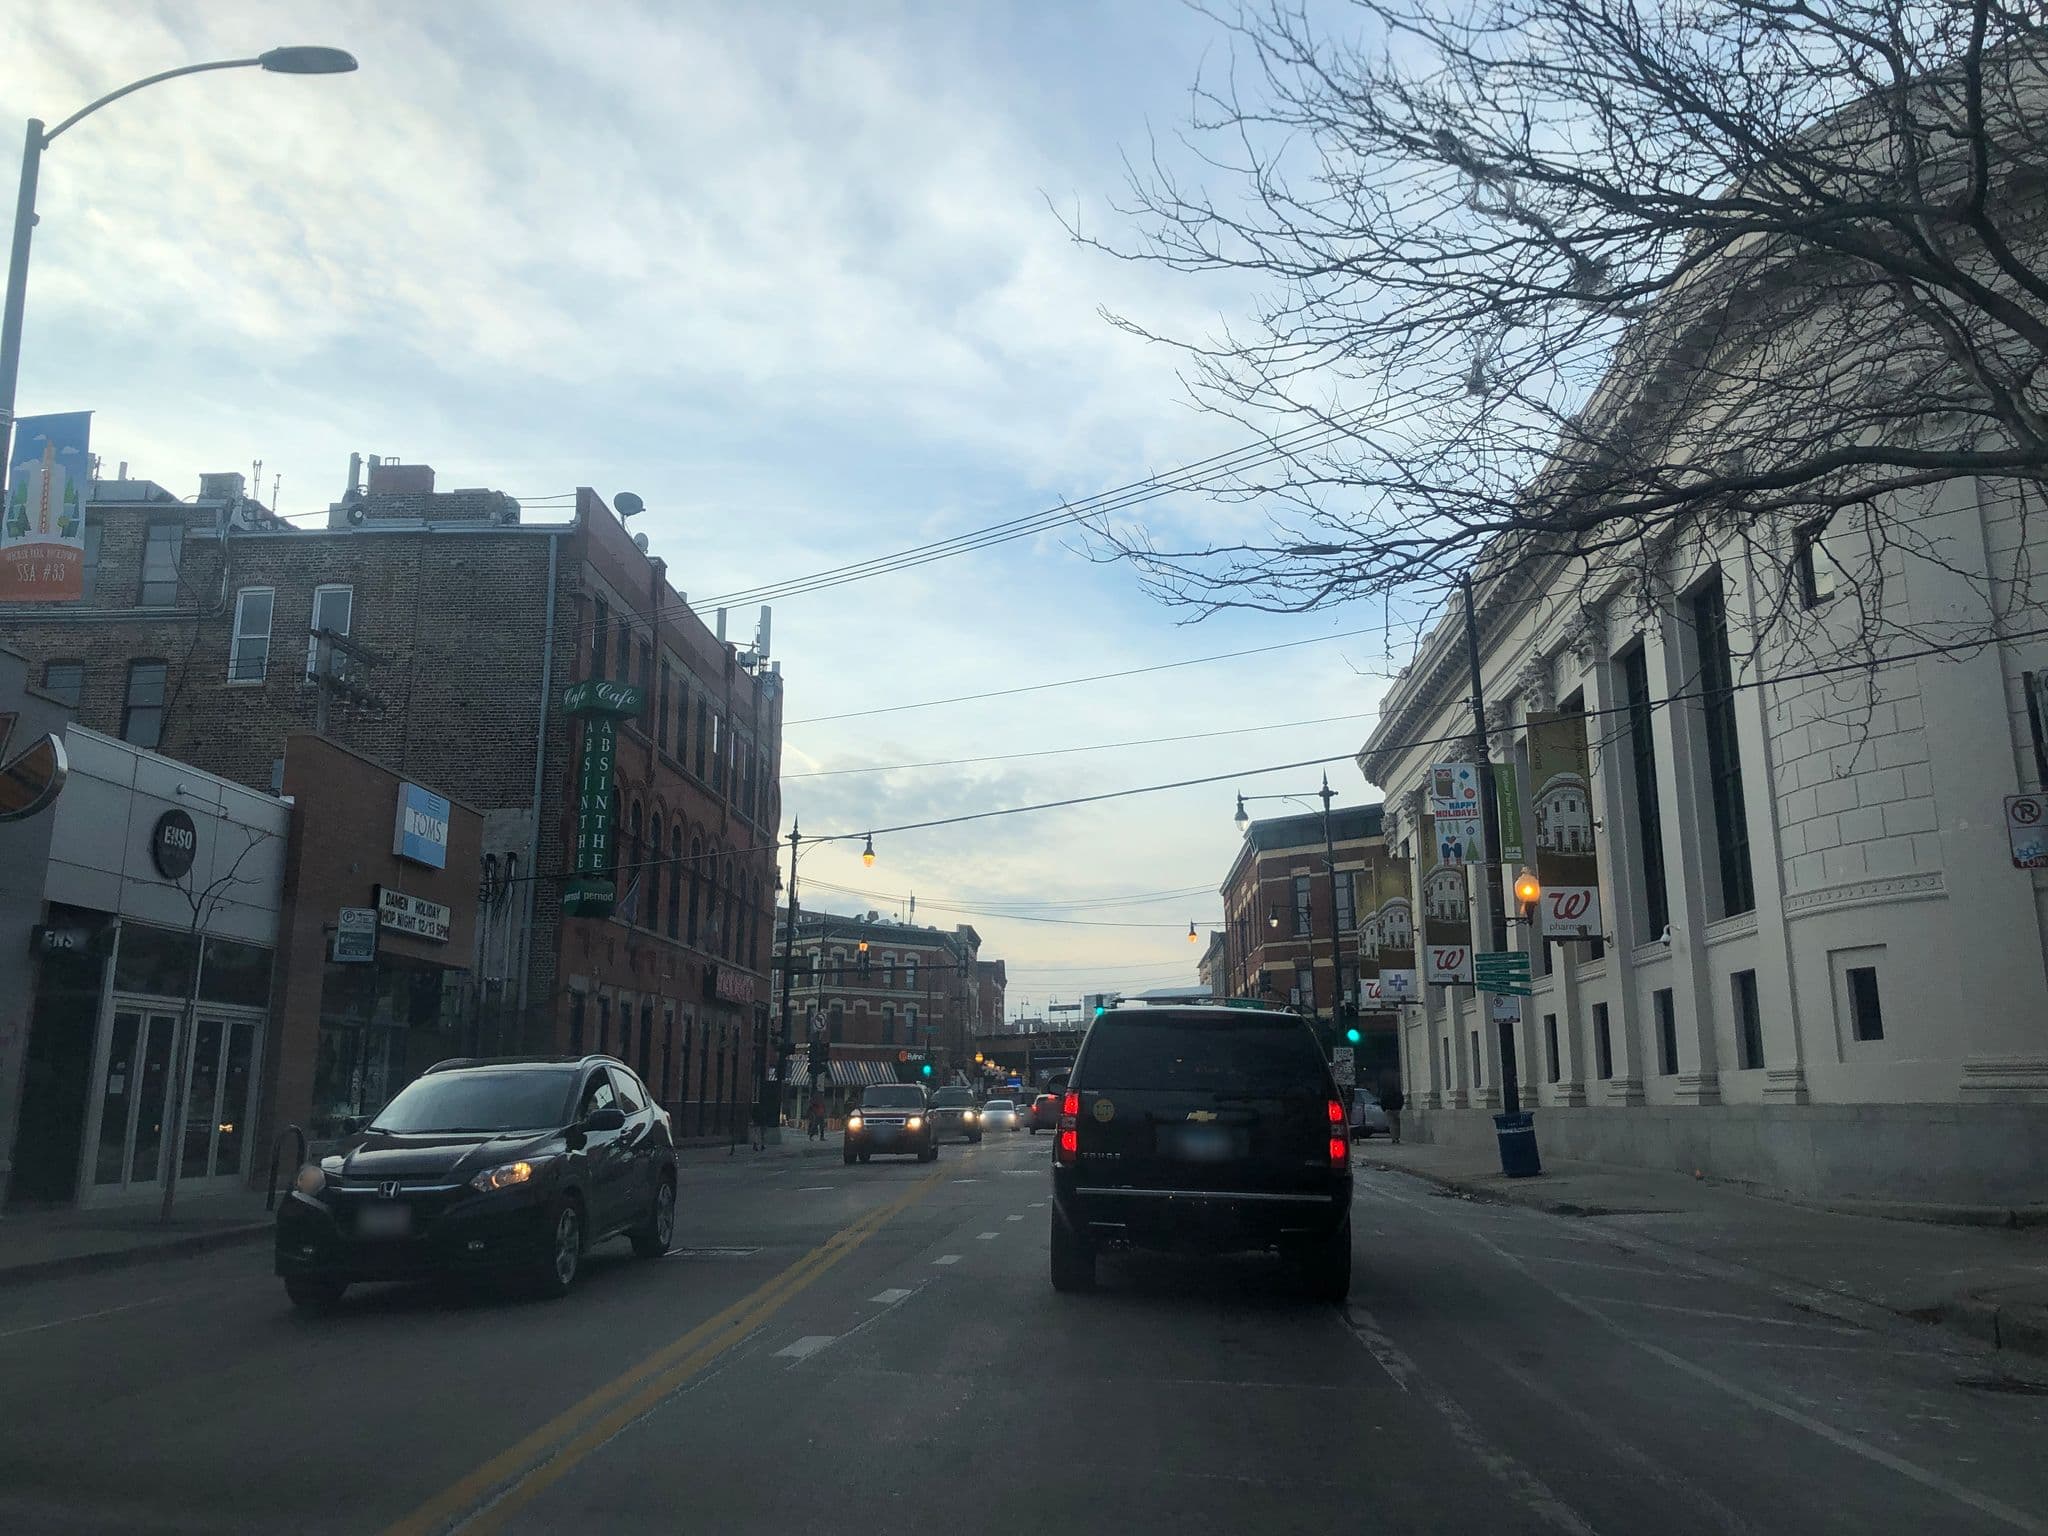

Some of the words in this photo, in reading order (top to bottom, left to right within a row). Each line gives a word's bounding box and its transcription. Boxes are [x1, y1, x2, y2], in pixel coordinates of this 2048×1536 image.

[17, 563, 36, 582] SSA
[42, 563, 65, 582] #33
[595, 682, 638, 710] Cafe
[577, 719, 594, 869] ABSINTHE
[592, 719, 614, 868] ABSINTHE
[1449, 801, 1477, 809] HAPPY
[413, 811, 442, 842] TOMS
[1436, 809, 1478, 818] HOLIDAYS
[164, 826, 193, 850] ENSO
[385, 892, 409, 911] DAMEN
[415, 901, 441, 920] HOLIDAY
